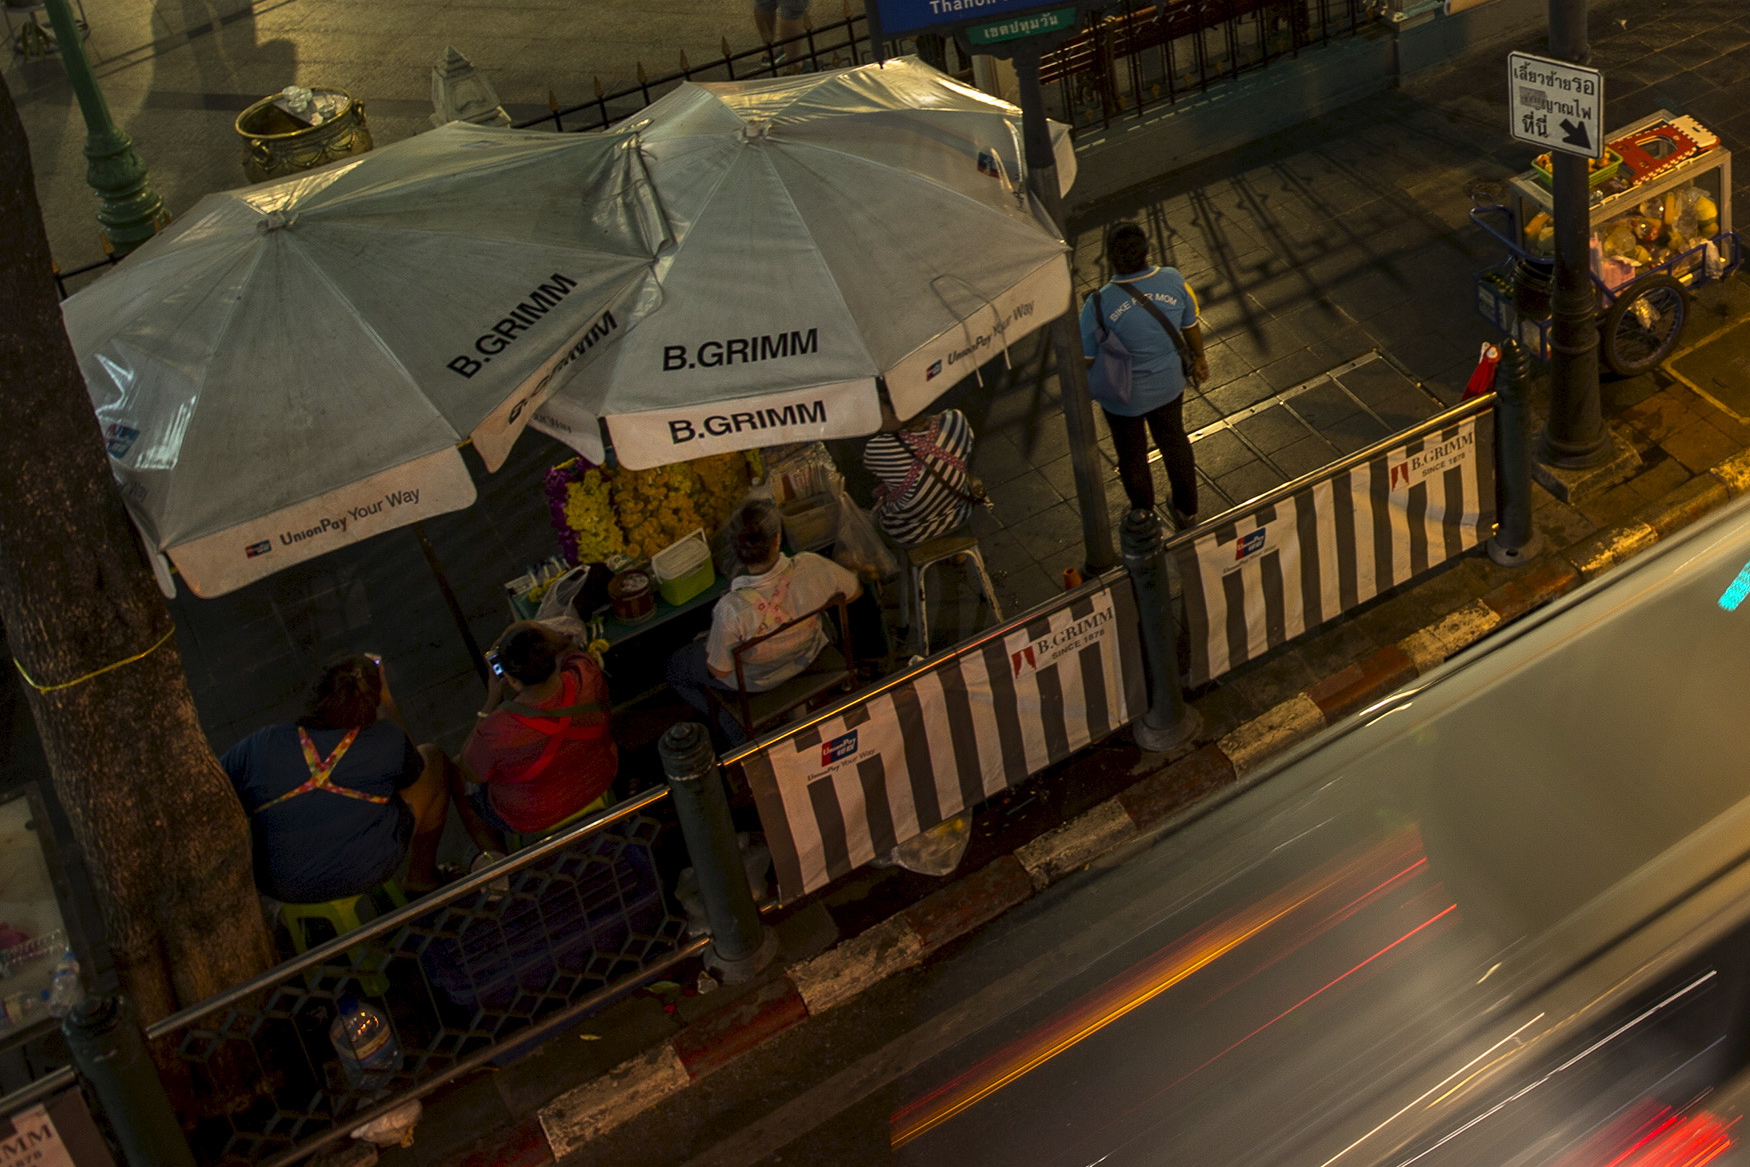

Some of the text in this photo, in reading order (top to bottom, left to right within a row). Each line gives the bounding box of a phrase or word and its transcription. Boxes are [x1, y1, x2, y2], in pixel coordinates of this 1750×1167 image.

[983, 12, 1059, 39] เขตปทุมวัน
[1522, 111, 1551, 138] ที่นี่
[1013, 300, 1035, 321] Way
[1109, 292, 1178, 322] BIKE FR MOM
[446, 273, 578, 379] B.GRIMM
[662, 327, 818, 371] B.GRIMM
[668, 400, 827, 444] B.GRIMM
[1411, 432, 1474, 471] B.GRIMM
[1421, 461, 1446, 477] SINCE
[279, 488, 420, 546] UnionPay Your Way
[1037, 606, 1114, 655] B.GRIMM
[1051, 628, 1105, 660] SINCE 1878
